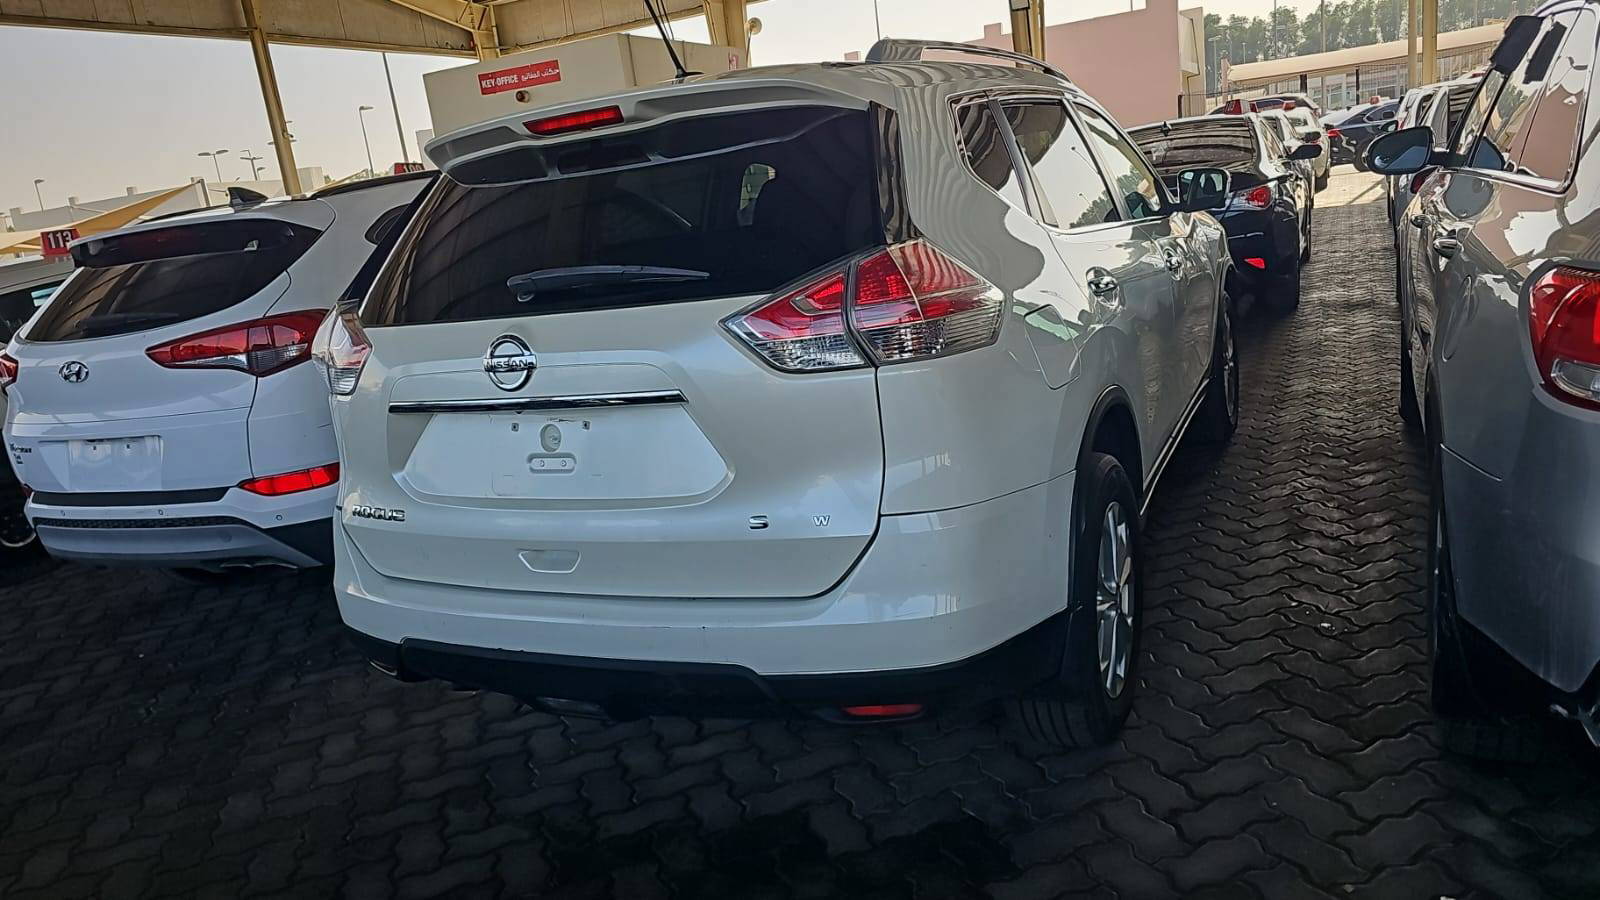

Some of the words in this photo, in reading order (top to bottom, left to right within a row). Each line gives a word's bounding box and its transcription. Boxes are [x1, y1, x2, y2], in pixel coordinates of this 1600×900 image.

[48, 230, 72, 250] 113
[486, 358, 528, 370] NISSAN
[352, 504, 406, 522] ROGUE
[748, 514, 769, 530] S
